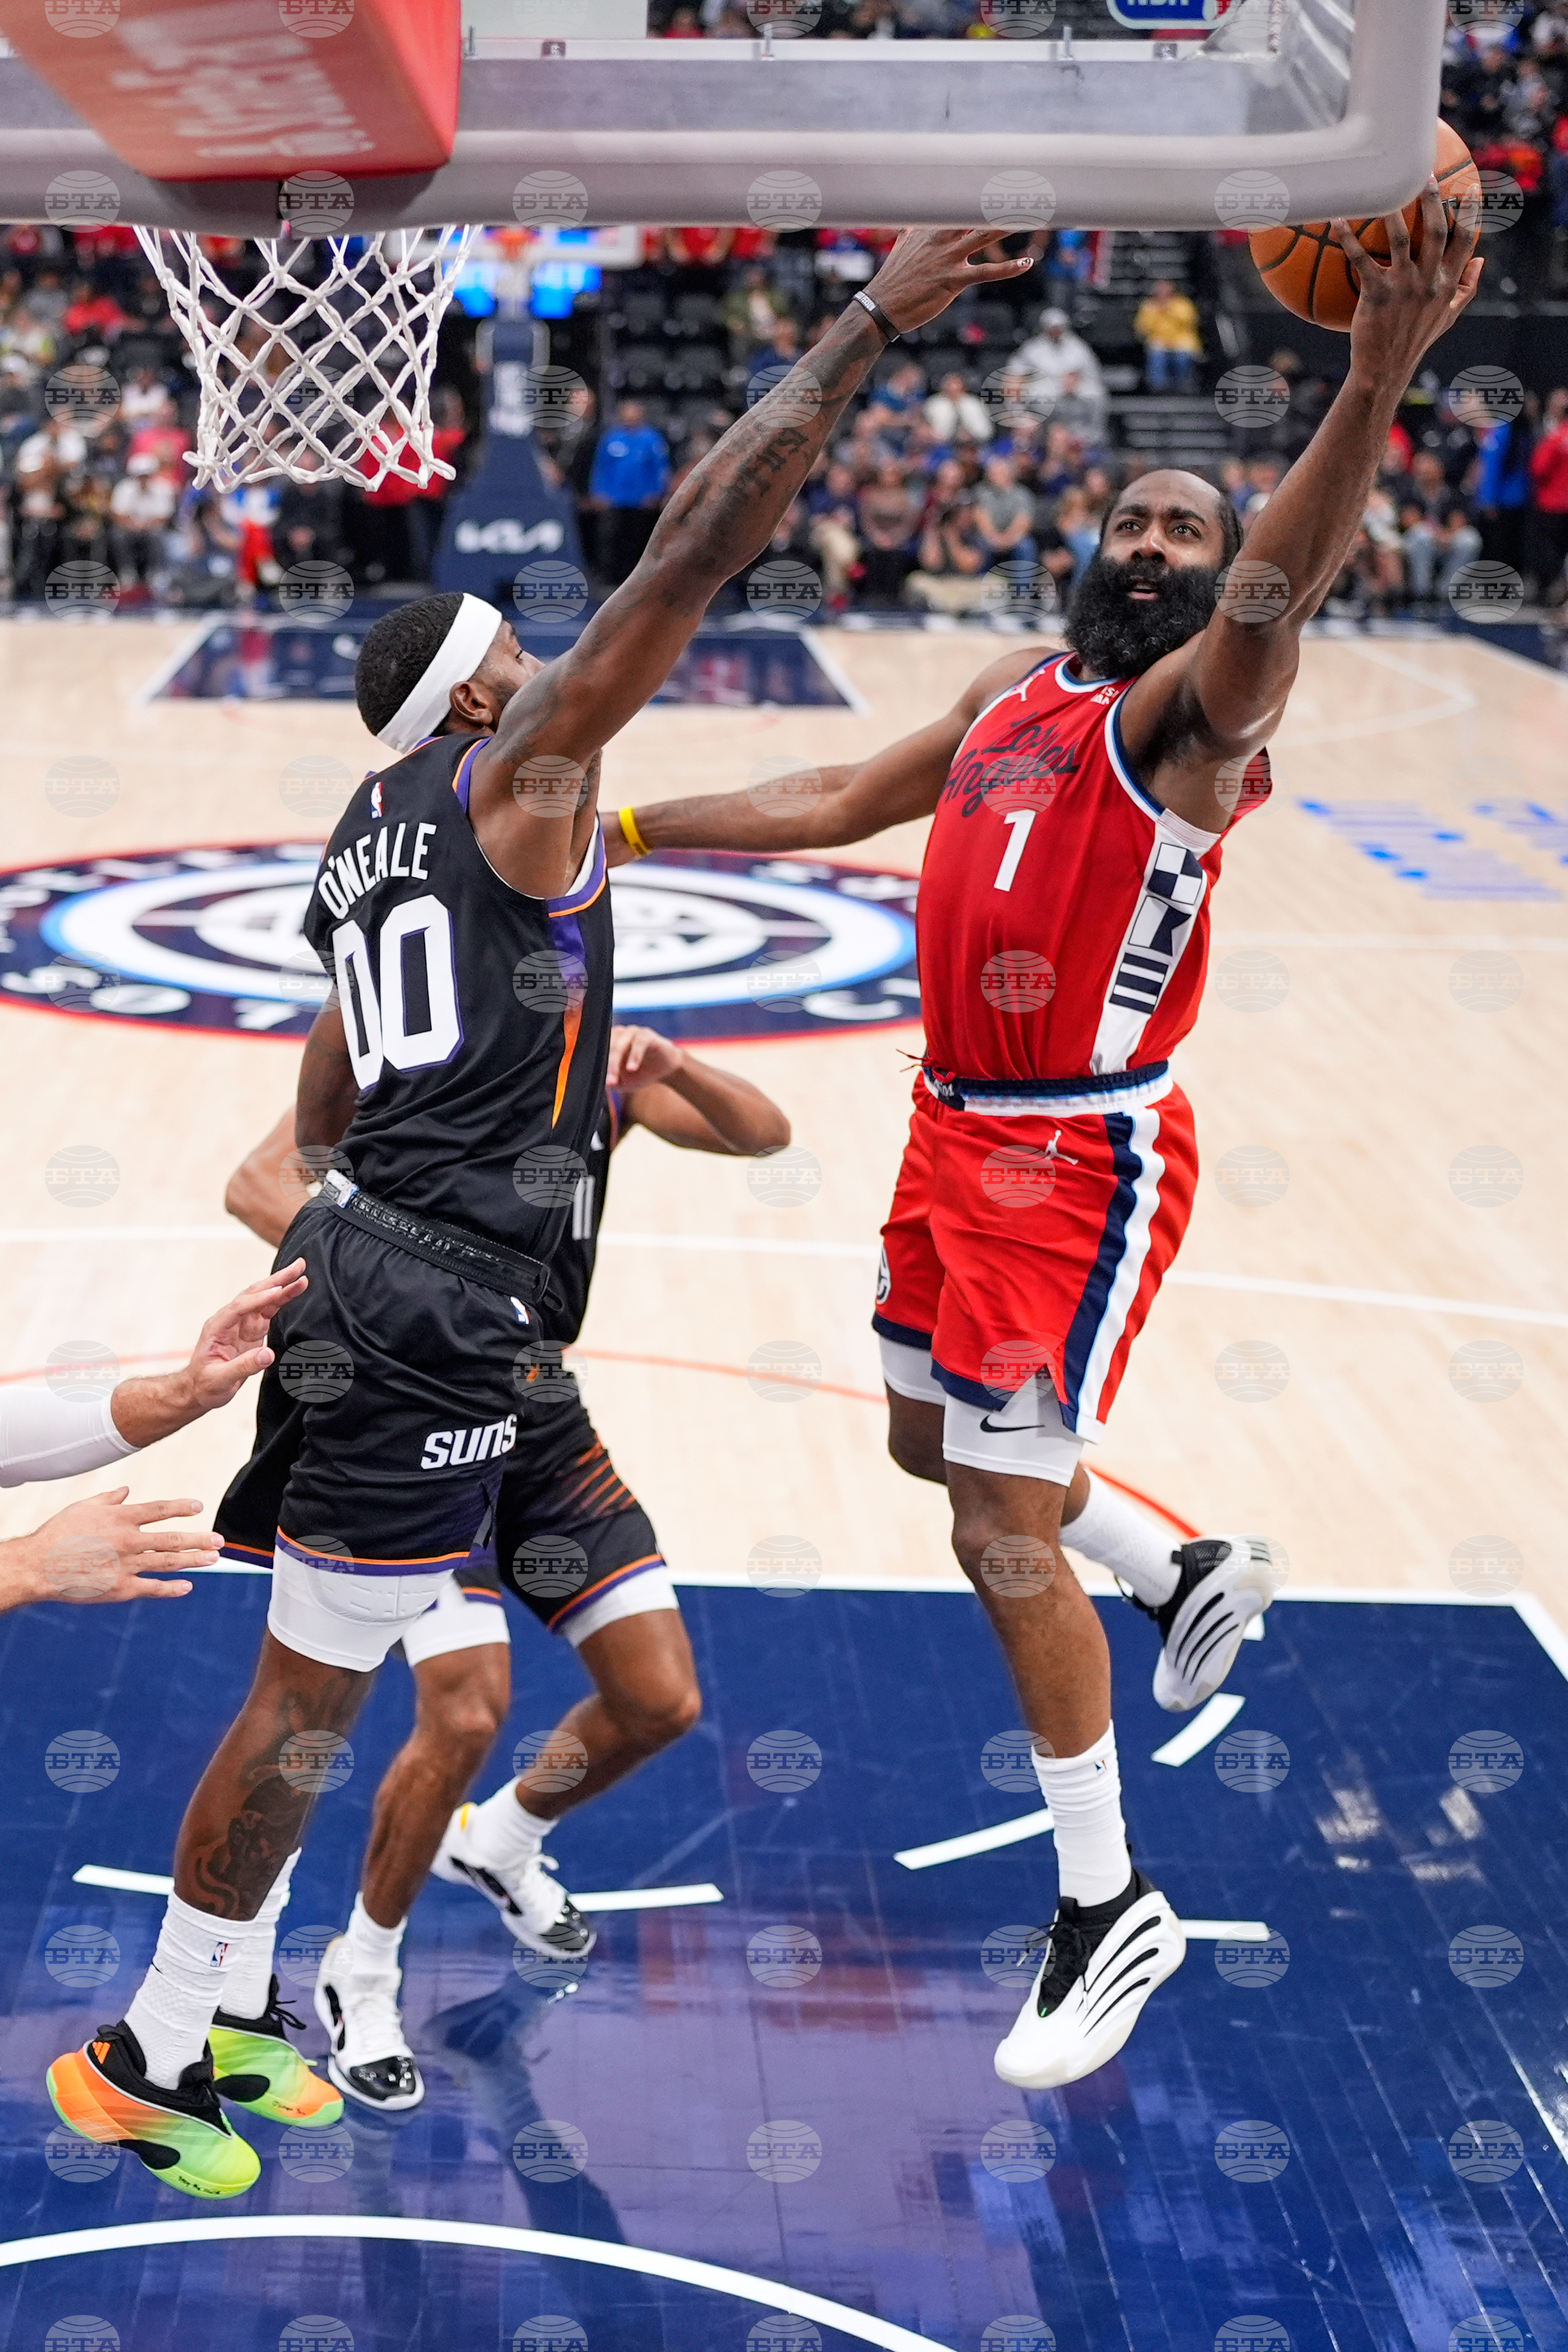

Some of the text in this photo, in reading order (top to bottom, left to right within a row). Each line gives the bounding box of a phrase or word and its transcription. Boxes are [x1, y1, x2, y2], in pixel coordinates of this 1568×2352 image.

[981, 712, 1060, 754] Los
[318, 822, 437, 920] O'NEALE
[994, 808, 1036, 892] 1
[332, 894, 464, 1092] 00
